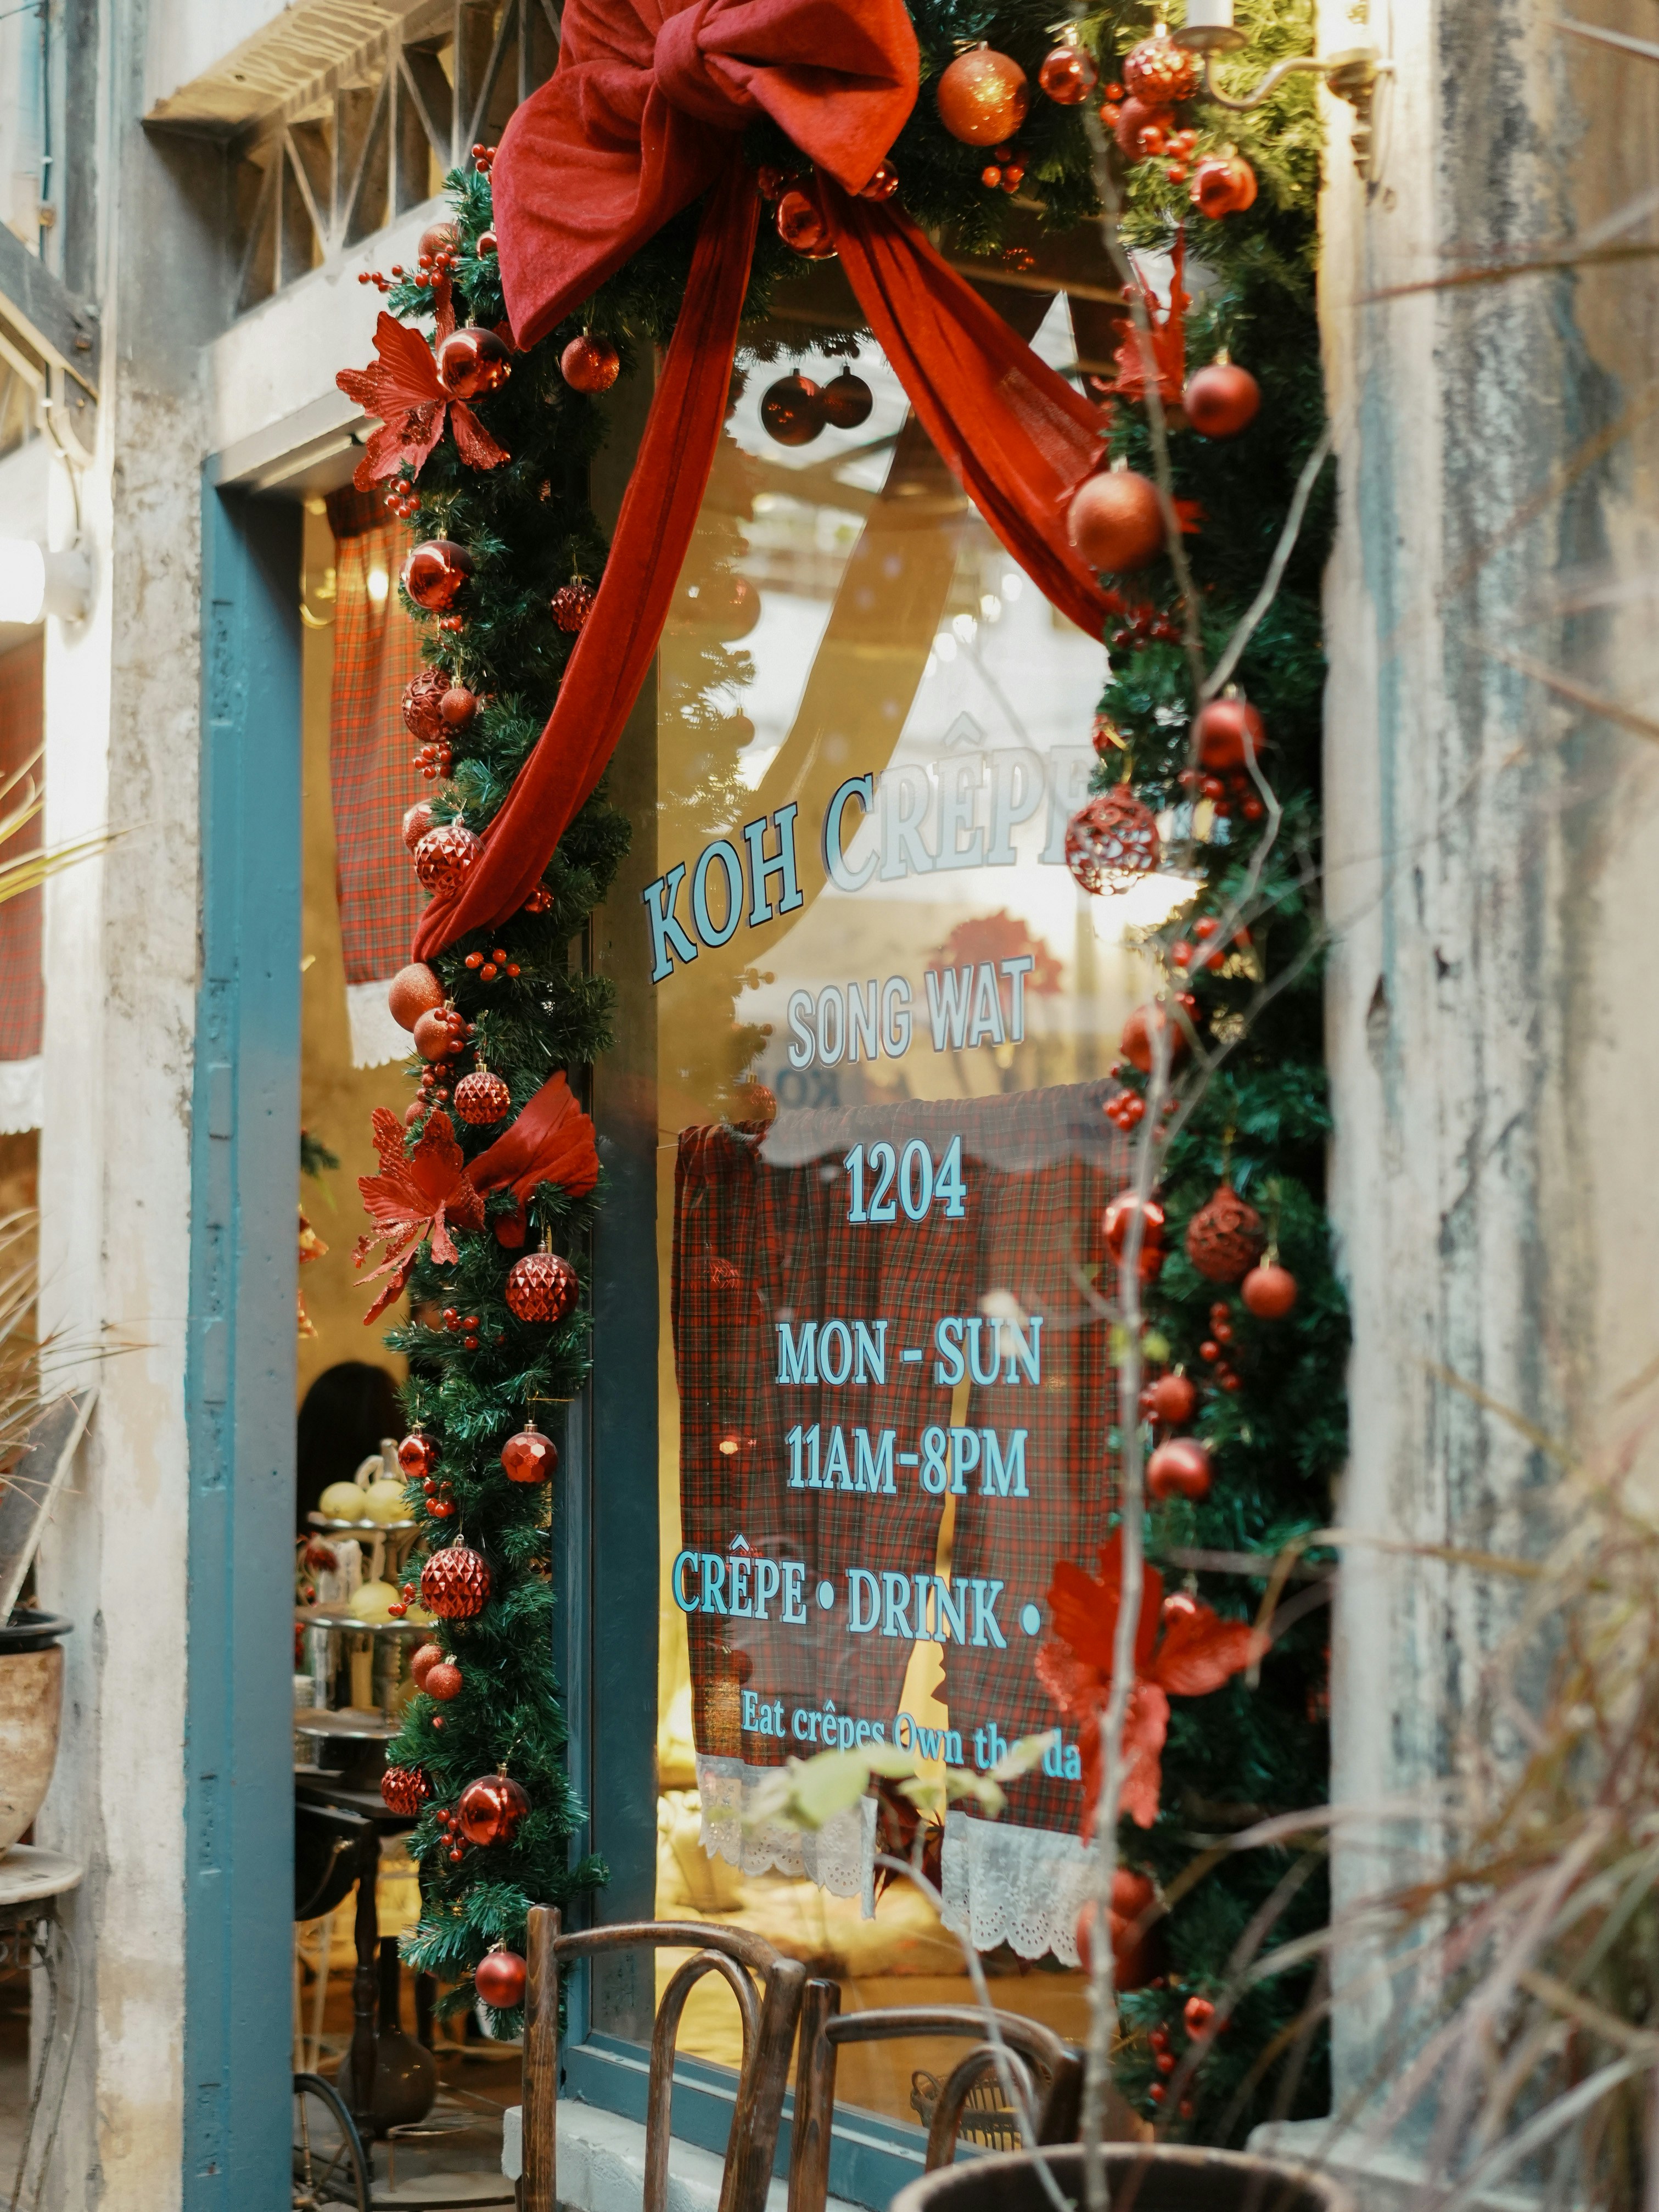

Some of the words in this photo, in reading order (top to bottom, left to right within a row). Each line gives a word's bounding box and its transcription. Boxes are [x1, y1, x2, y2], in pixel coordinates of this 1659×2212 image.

[640, 802, 805, 984] KOH
[787, 975, 912, 1071] SONG
[926, 955, 1034, 1053] WAT
[844, 1135, 967, 1224] 1204
[776, 1319, 888, 1386] MON
[934, 1317, 1043, 1387] SUN
[784, 1424, 1030, 1498] 11AM-8PM
[672, 1533, 808, 1625] CRÊPE
[846, 1568, 1007, 1648] DRINK
[741, 1689, 786, 1738] Eat
[792, 1699, 885, 1754] crêpes
[893, 1712, 964, 1765] Own
